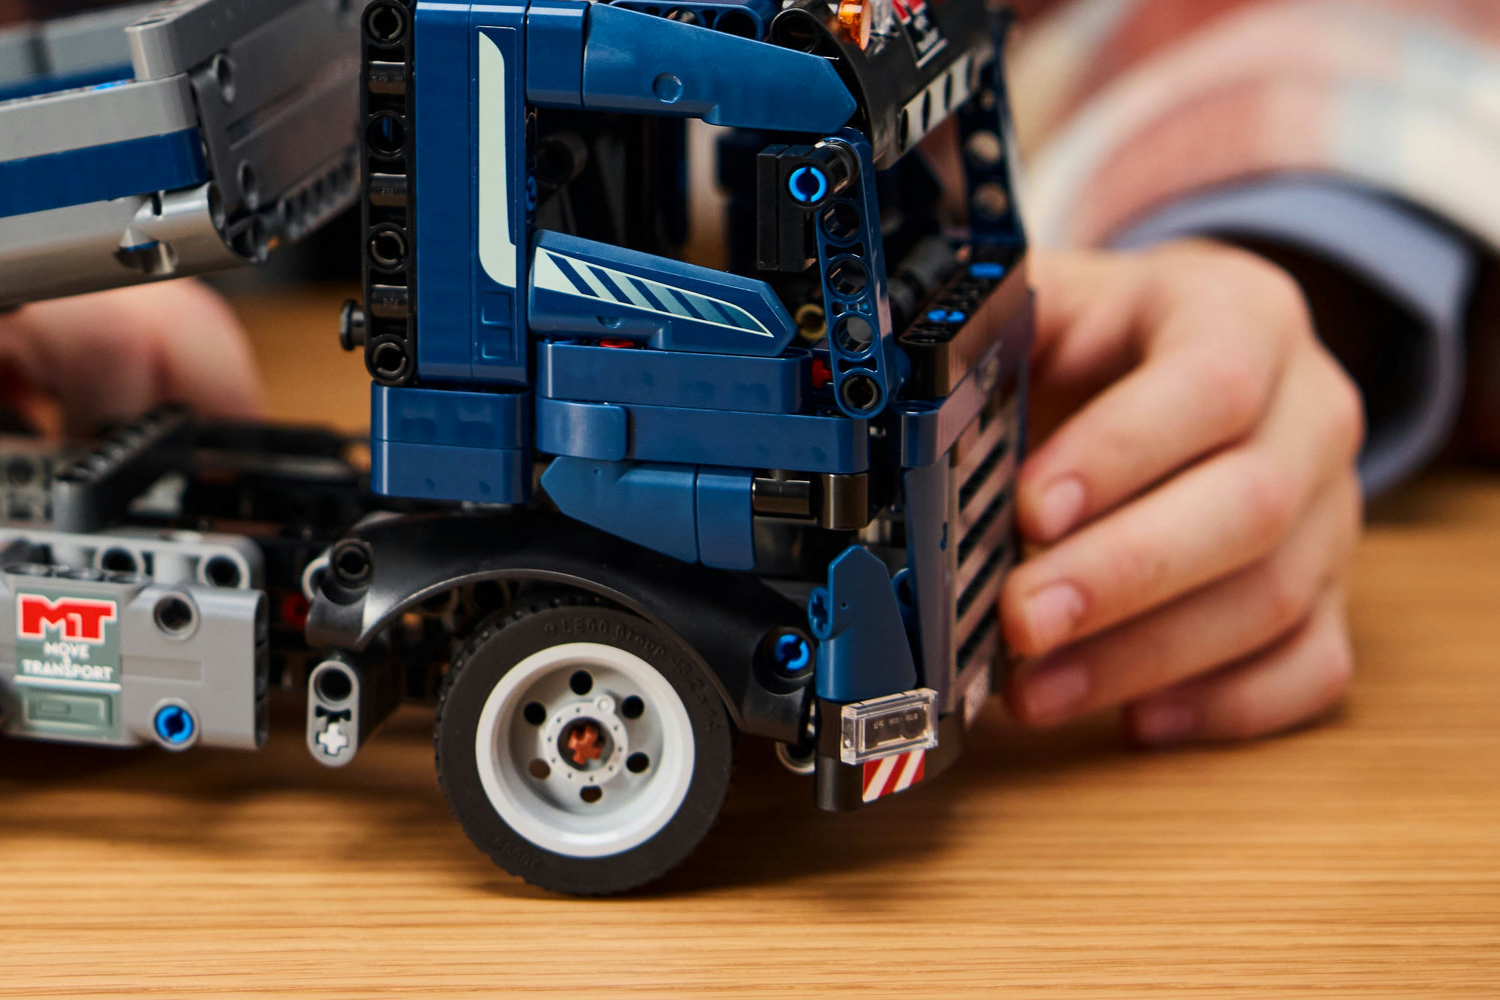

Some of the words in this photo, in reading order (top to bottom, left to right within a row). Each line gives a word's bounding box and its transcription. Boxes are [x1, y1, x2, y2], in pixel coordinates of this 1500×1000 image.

[17, 593, 118, 646] MT
[560, 617, 610, 633] LEGO
[44, 642, 91, 661] MOVE
[22, 660, 115, 682] TRANSPORT
